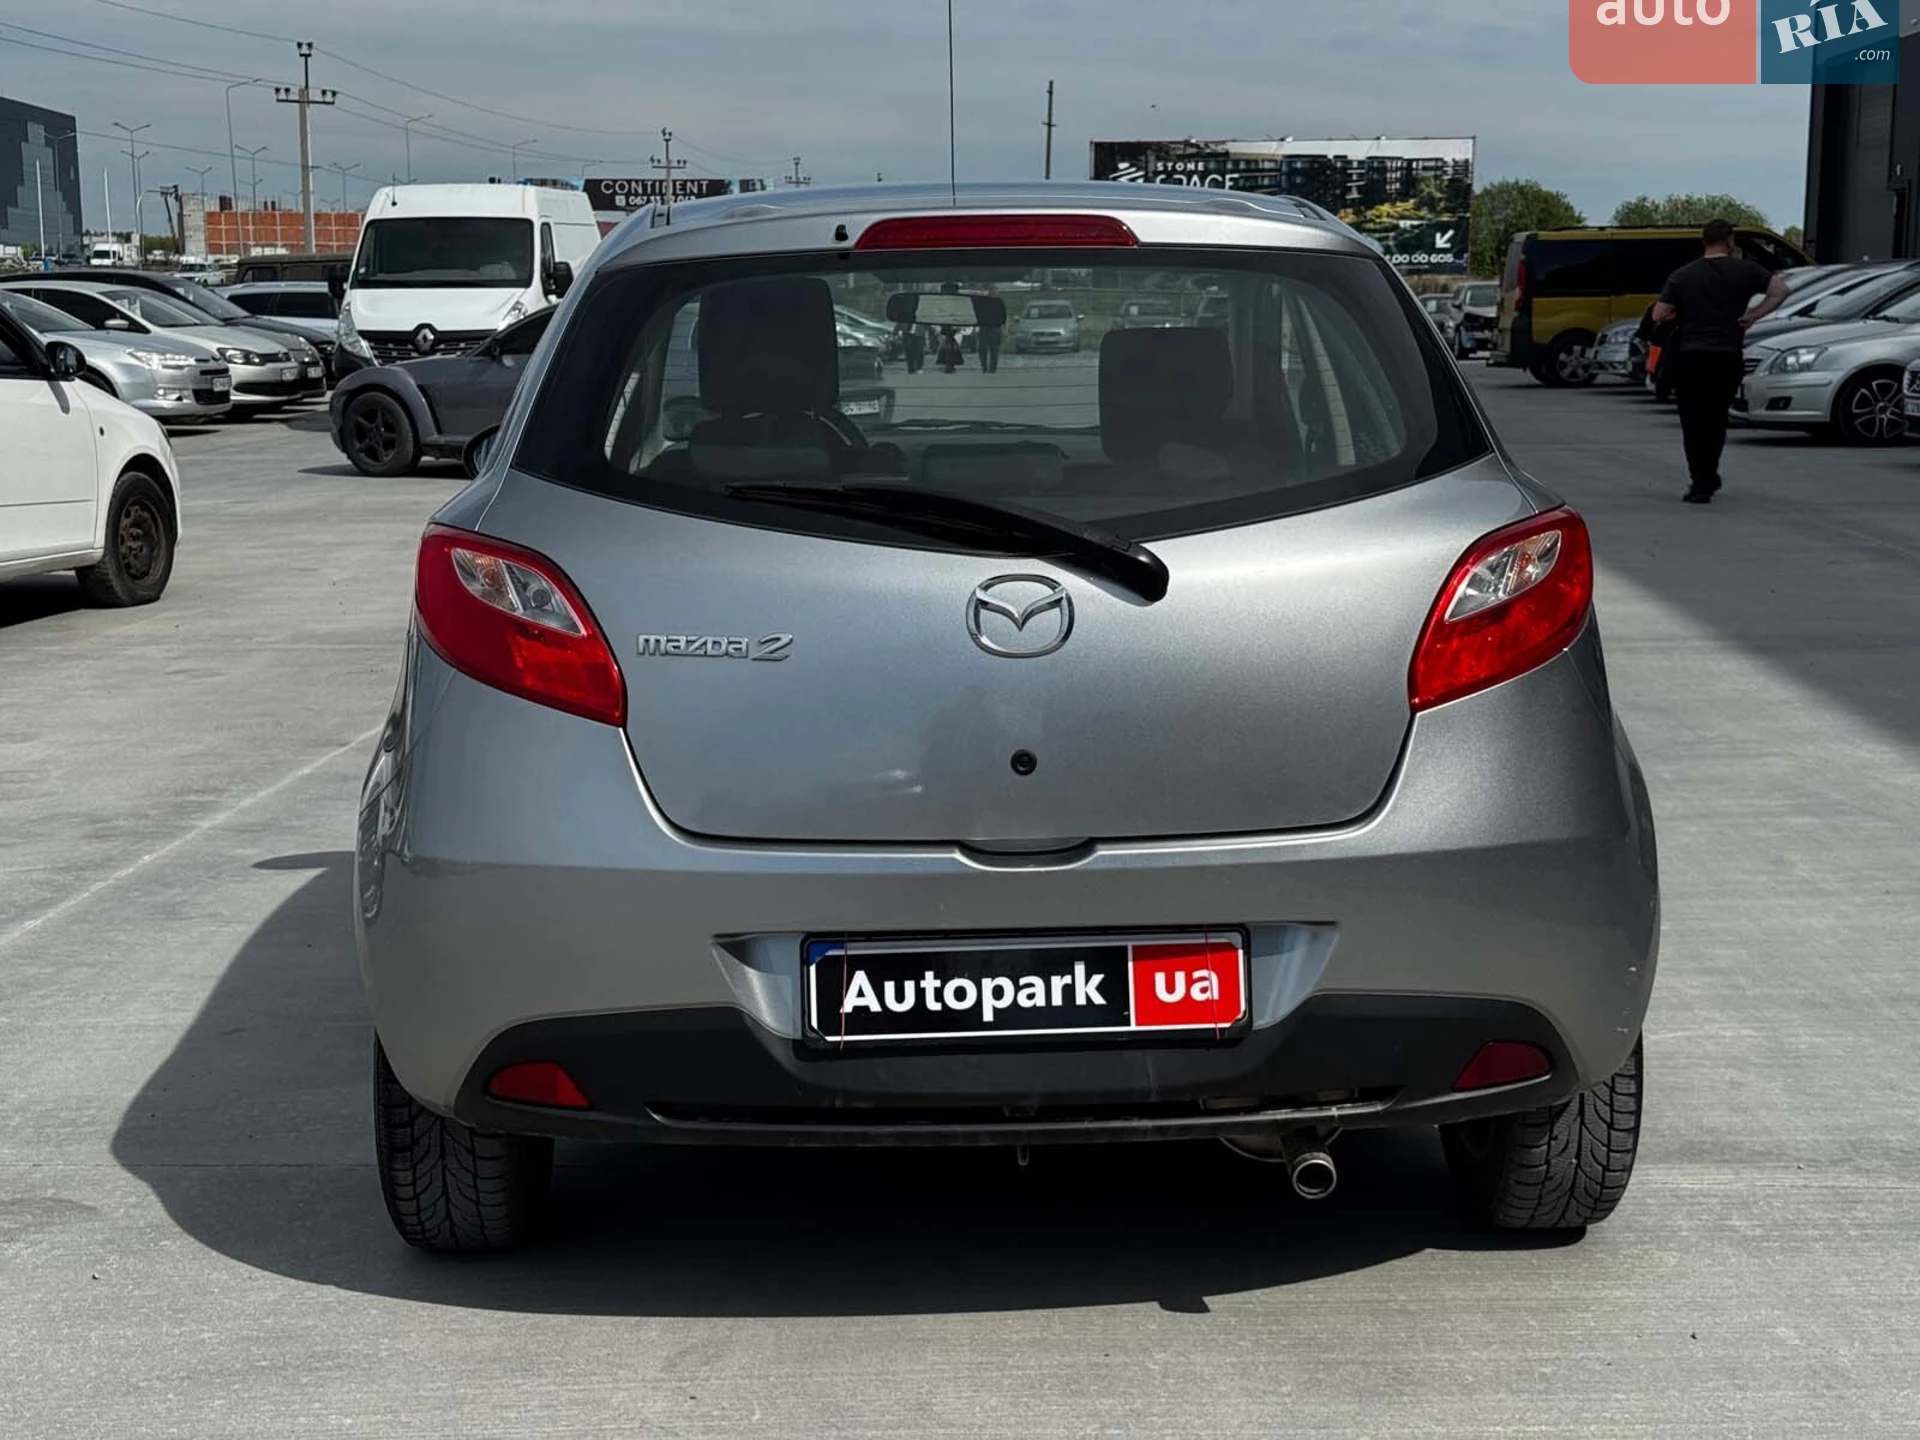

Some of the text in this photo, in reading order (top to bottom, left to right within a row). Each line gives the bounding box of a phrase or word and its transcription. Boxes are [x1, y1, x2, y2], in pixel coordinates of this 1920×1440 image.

[1156, 162, 1205, 172] STONE
[840, 960, 1219, 1022] Autopark ua
